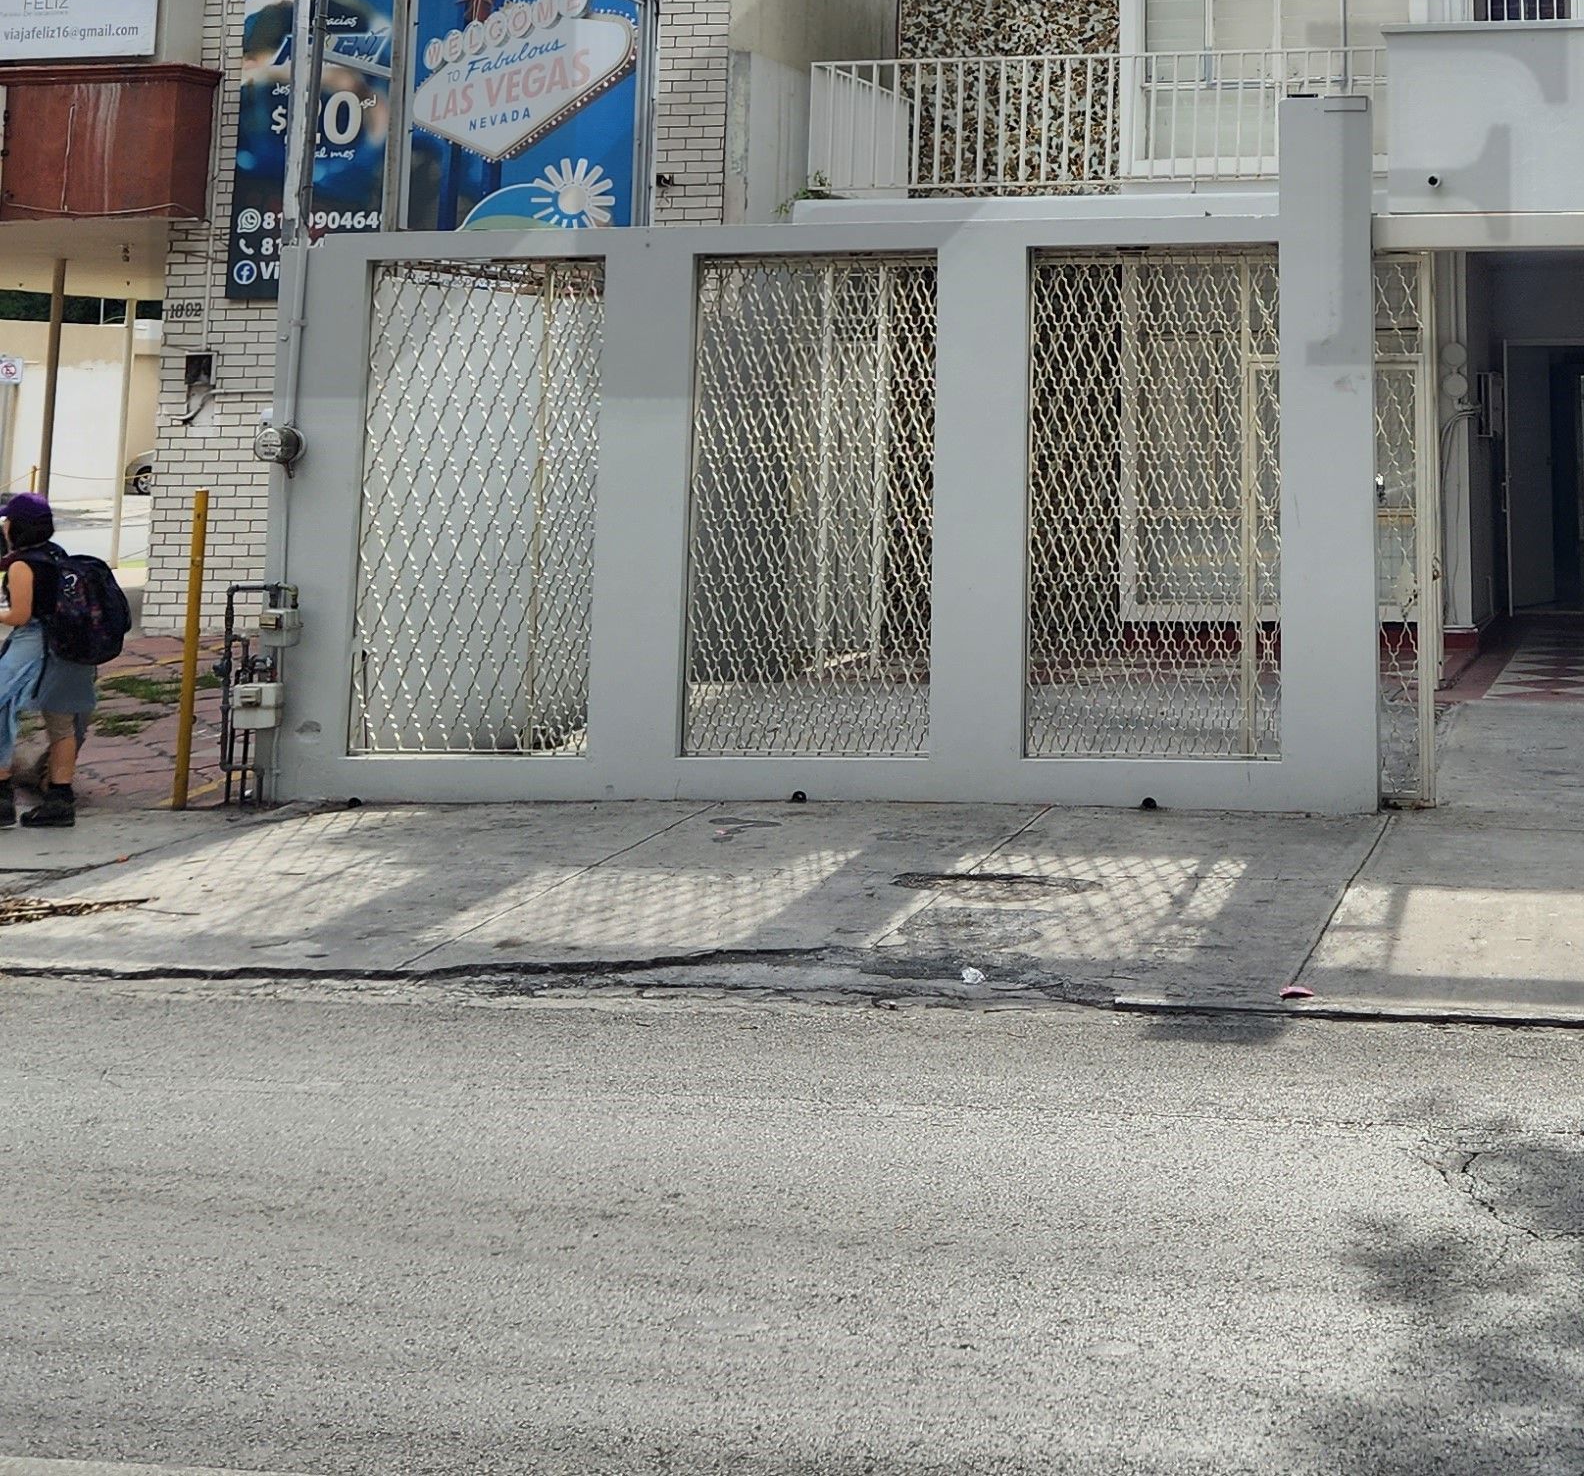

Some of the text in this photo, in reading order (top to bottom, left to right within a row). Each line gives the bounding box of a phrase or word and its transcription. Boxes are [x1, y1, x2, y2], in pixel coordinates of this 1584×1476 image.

[3, 24, 139, 42] viajafeliz16@gmail.com
[465, 38, 567, 82] Fabulous
[430, 49, 592, 123] LAS VEGAS
[469, 107, 531, 131] NEVADA
